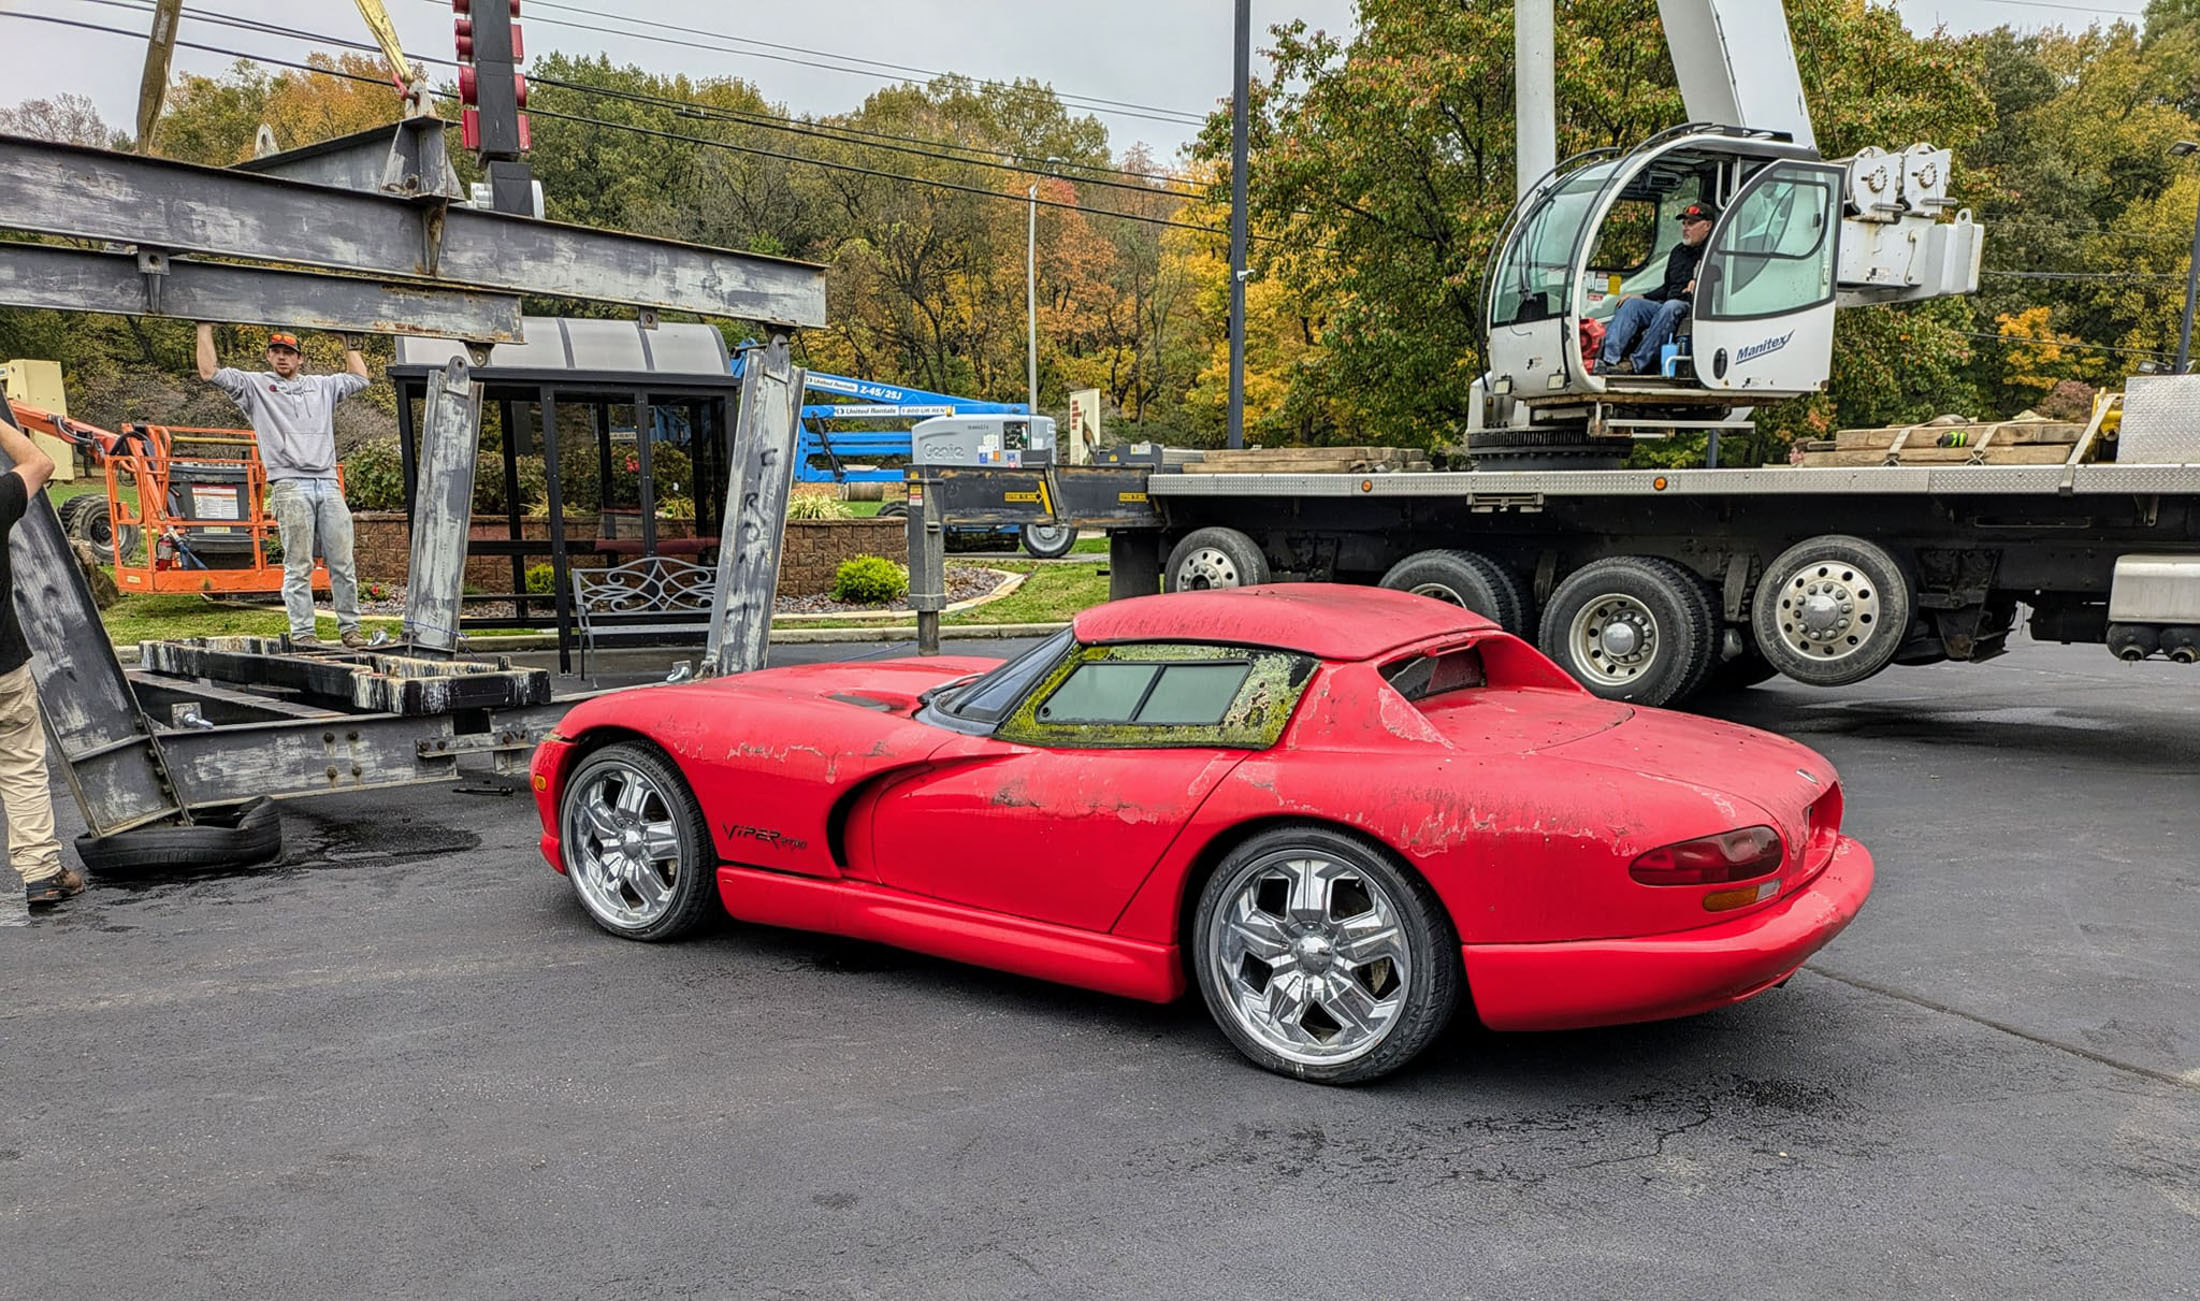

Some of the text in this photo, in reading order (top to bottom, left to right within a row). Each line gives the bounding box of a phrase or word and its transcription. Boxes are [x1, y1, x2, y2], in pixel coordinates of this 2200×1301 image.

[1736, 332, 1790, 363] Manitex
[846, 407, 897, 415] United Rentals
[924, 442, 965, 460] Genie
